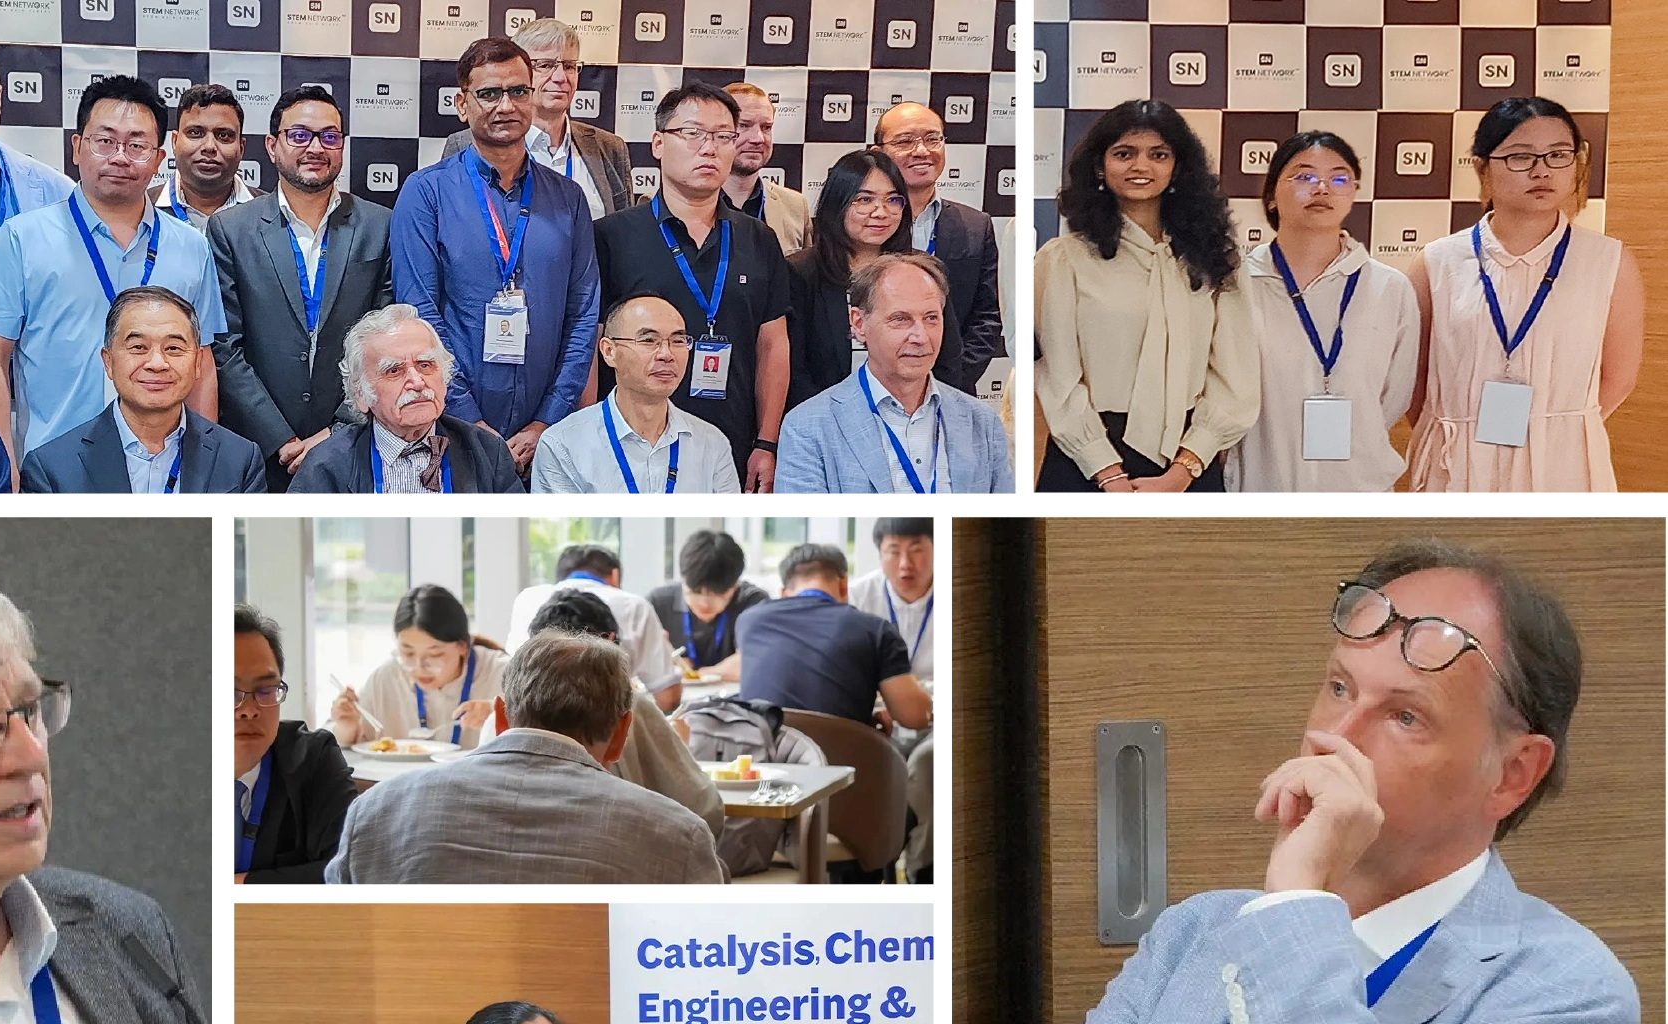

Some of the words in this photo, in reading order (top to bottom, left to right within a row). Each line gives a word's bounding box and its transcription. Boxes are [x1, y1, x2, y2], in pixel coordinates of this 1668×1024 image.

[375, 12, 395, 24] SN
[641, 21, 660, 33] SN
[892, 29, 911, 40] SN
[1176, 62, 1199, 76] SN
[1332, 64, 1355, 77] SN
[1485, 65, 1508, 78] SN
[14, 81, 37, 94] SN
[828, 102, 847, 114] SN
[1248, 151, 1272, 166] SN
[373, 171, 393, 183] SN
[635, 175, 655, 187] SN
[880, 986, 916, 1019] &
